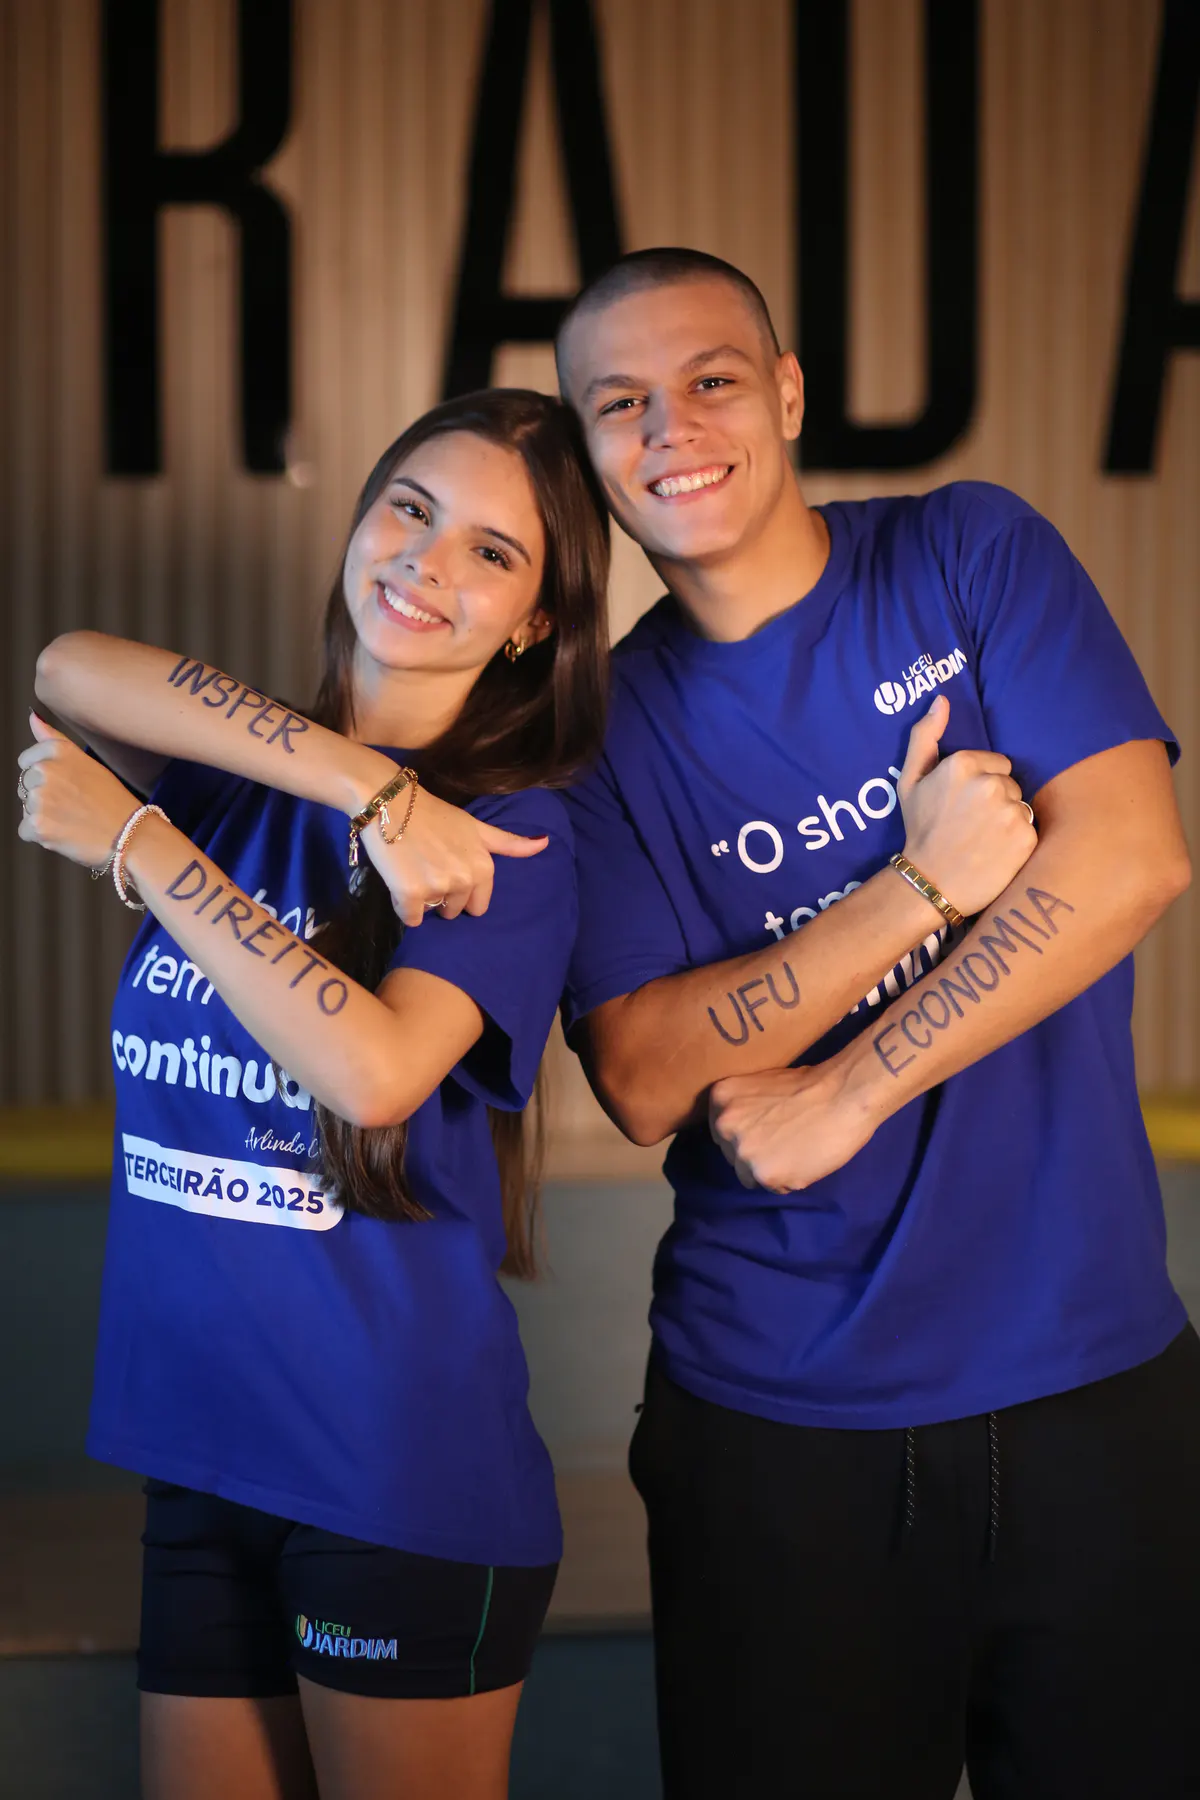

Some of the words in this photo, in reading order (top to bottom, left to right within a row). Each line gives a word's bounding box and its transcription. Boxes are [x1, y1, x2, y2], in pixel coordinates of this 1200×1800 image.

[902, 653, 933, 681] LICEU
[167, 656, 309, 754] INSPER
[797, 766, 902, 851] sho
[165, 859, 348, 1016] DIREITO
[707, 961, 800, 1046] UFU
[872, 887, 1075, 1077] ECONOMIA
[245, 1126, 306, 1155] Arlindo
[307, 1138, 322, 1158] C
[125, 1151, 249, 1203] TERCEIRÃO
[256, 1181, 325, 1214] 2025
[312, 1632, 398, 1660] JARDIM
[315, 1619, 352, 1638] LICEU
